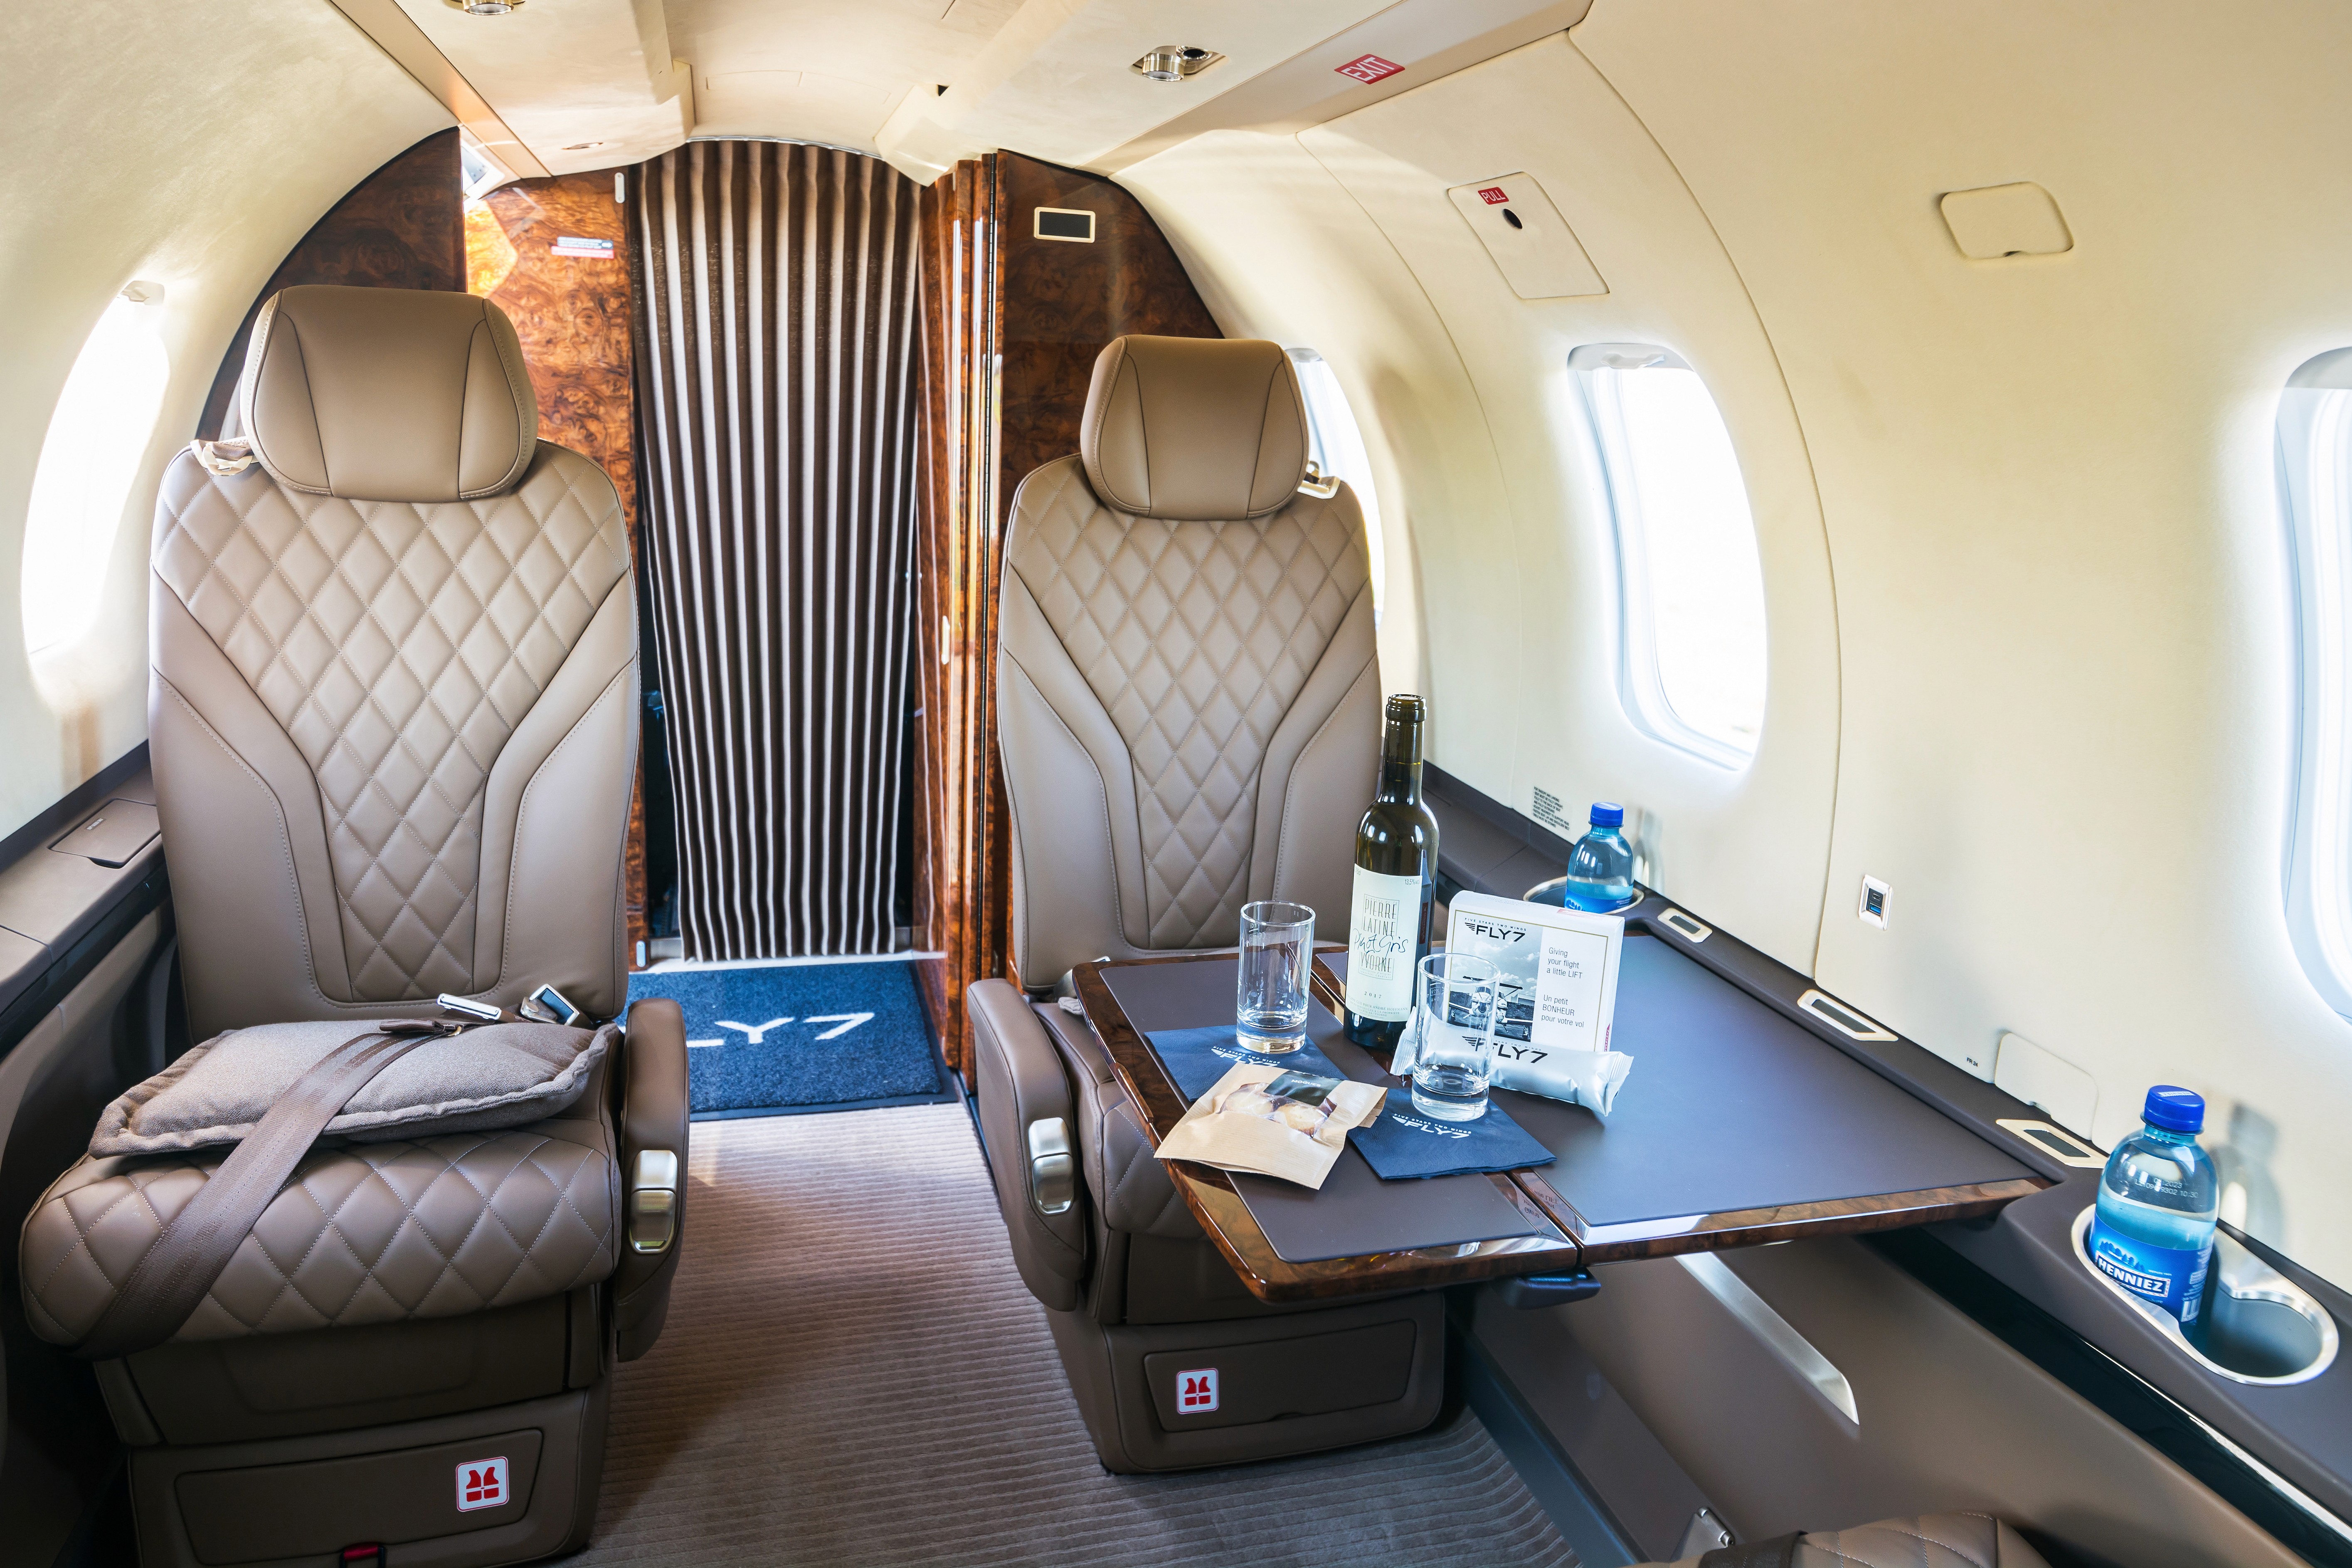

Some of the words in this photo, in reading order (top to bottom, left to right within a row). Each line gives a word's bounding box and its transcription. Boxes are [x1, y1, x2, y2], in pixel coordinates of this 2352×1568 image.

[1341, 57, 1395, 81] EXIT
[1481, 190, 1506, 202] PULL
[1365, 898, 1397, 919] PIERRE
[1363, 916, 1396, 936] LATINE
[1476, 925, 1526, 942] FLY7
[1353, 928, 1381, 953] Pinot
[1379, 934, 1408, 958] Gris
[1549, 947, 1568, 958] Giving
[1361, 952, 1393, 973] YVORNE
[1563, 960, 1579, 969] flight
[1553, 968, 1566, 976] little
[1568, 970, 1583, 979] LIFT
[1543, 1004, 1575, 1016] BONHEUR
[1404, 1120, 1469, 1139] FLY7
[2098, 1257, 2163, 1292] HENNIEZ
